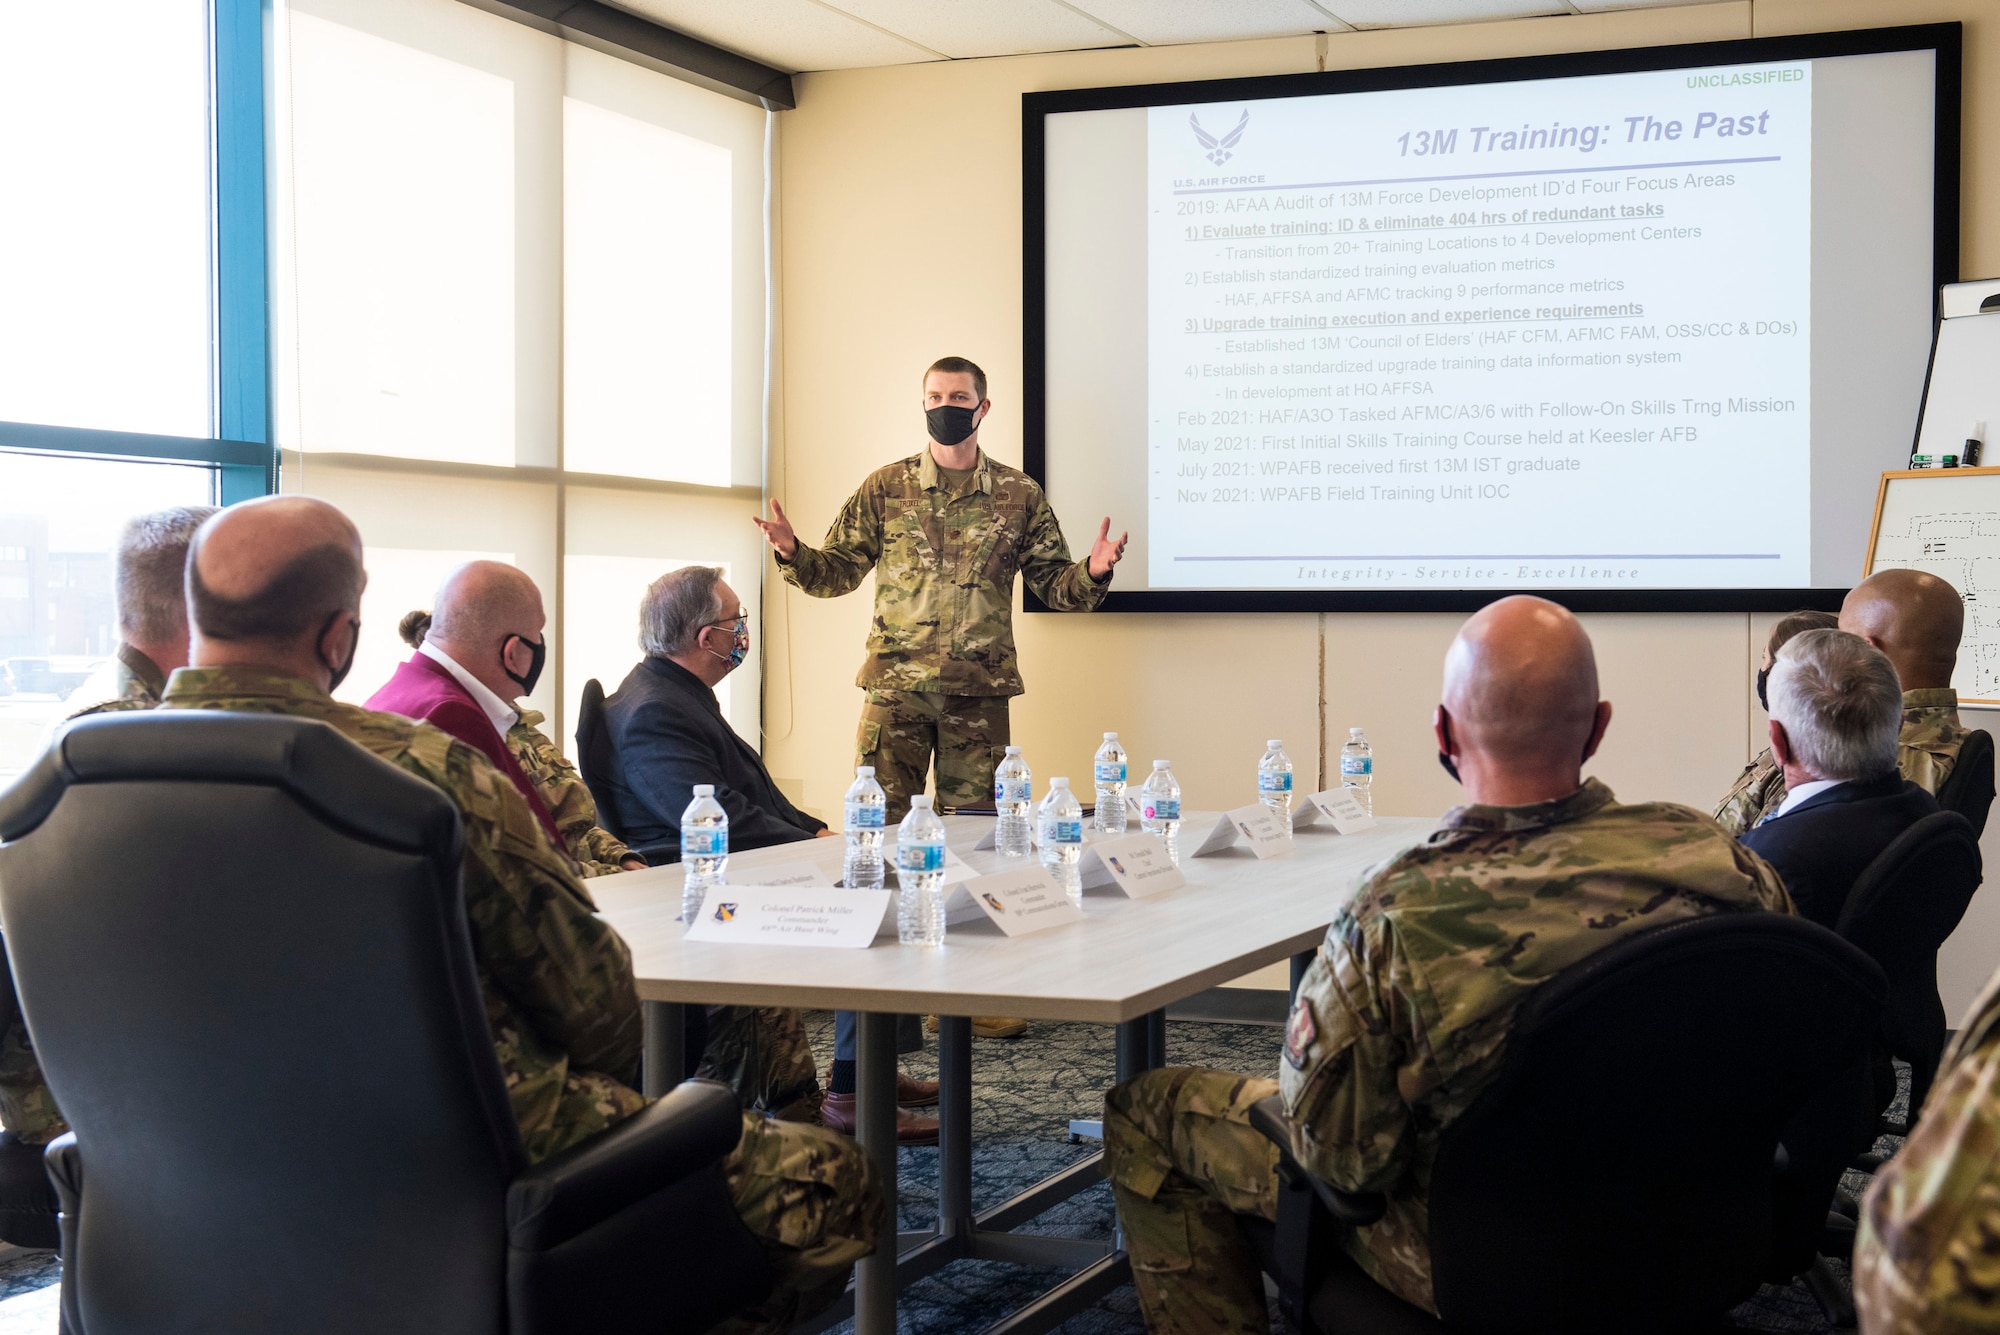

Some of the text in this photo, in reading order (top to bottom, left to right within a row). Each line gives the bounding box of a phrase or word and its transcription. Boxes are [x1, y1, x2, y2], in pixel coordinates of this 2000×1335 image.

[1686, 69, 1804, 88] UNCLASSIFIED
[1396, 109, 1770, 157] 13M Training: The Past
[1173, 175, 1266, 188] U.S. AIR FORCE
[1177, 200, 1219, 216] 2019:
[1224, 198, 1269, 213] AFAA
[1274, 195, 1314, 211] Audit
[1318, 193, 1334, 208] of
[1339, 192, 1372, 207] 13M
[1379, 189, 1423, 205] Force
[1429, 183, 1537, 203] Development
[1582, 178, 1620, 194] Four
[1626, 176, 1678, 191] Focus
[1684, 172, 1735, 188] Areas
[1185, 202, 1664, 241] 1) Evaluate training: ID & eliminate 404 hrs of redundant tasks
[1225, 245, 1292, 260] Transition
[1298, 243, 1329, 257] from
[1333, 242, 1360, 255] 20+
[1365, 239, 1423, 257] Training
[1428, 234, 1498, 250] Locations
[1503, 234, 1516, 247] to
[1521, 233, 1530, 246] 4
[1536, 228, 1636, 249] Development
[1641, 226, 1702, 240] Centers
[1185, 258, 1555, 287] 2) Establish standardized training evaluation metrics
[1225, 293, 1258, 309] HAF,
[1262, 291, 1314, 305] AFFSA
[1316, 290, 1342, 303] and
[1346, 288, 1391, 302] AFMC
[1395, 285, 1452, 303] tracking
[1457, 285, 1466, 297] 9
[1471, 281, 1564, 299] performance
[1569, 279, 1624, 292] metrics
[1185, 302, 1644, 334] 3) Upgrade training execution and experience requirements
[1225, 339, 1305, 353] Established
[1311, 338, 1340, 351] 13M
[1406, 334, 1420, 347] of
[1479, 331, 1516, 346] (HAF
[1522, 329, 1562, 345] CFM,
[1567, 327, 1615, 342] AFMC
[1620, 325, 1660, 341] FAM,
[1665, 322, 1733, 339] OSS/CC
[1738, 322, 1750, 336] &
[1756, 320, 1797, 337] DOs)
[1185, 350, 1681, 379] 4) Establish a standardized upgrade training data information system
[1225, 387, 1238, 399] In
[1242, 384, 1332, 401] development
[1336, 384, 1350, 397] at
[1354, 383, 1377, 397] HQ
[1381, 382, 1434, 395] AFFSA
[1177, 411, 1206, 425] Feb
[1211, 410, 1254, 425] 2021:
[1339, 407, 1396, 422] Tasked
[1402, 404, 1495, 421] AFMC/A3/6
[1501, 402, 1533, 418] with
[1540, 401, 1625, 417] Follow-On
[1631, 399, 1676, 415] Skills
[1682, 399, 1721, 417] Trng
[1728, 397, 1795, 413] Mission
[1177, 427, 1697, 455] May 2021: First Initial Skills Training Course held at Keesler AFB
[1177, 456, 1580, 480] July 2021: WPAFB received first 13M IST graduate
[1177, 484, 1510, 503] Nov 2021: WPAFB Field Training Unit IOC
[1297, 567, 1395, 581] Integrity
[1415, 565, 1496, 579] Service
[1517, 565, 1640, 579] Excellence
